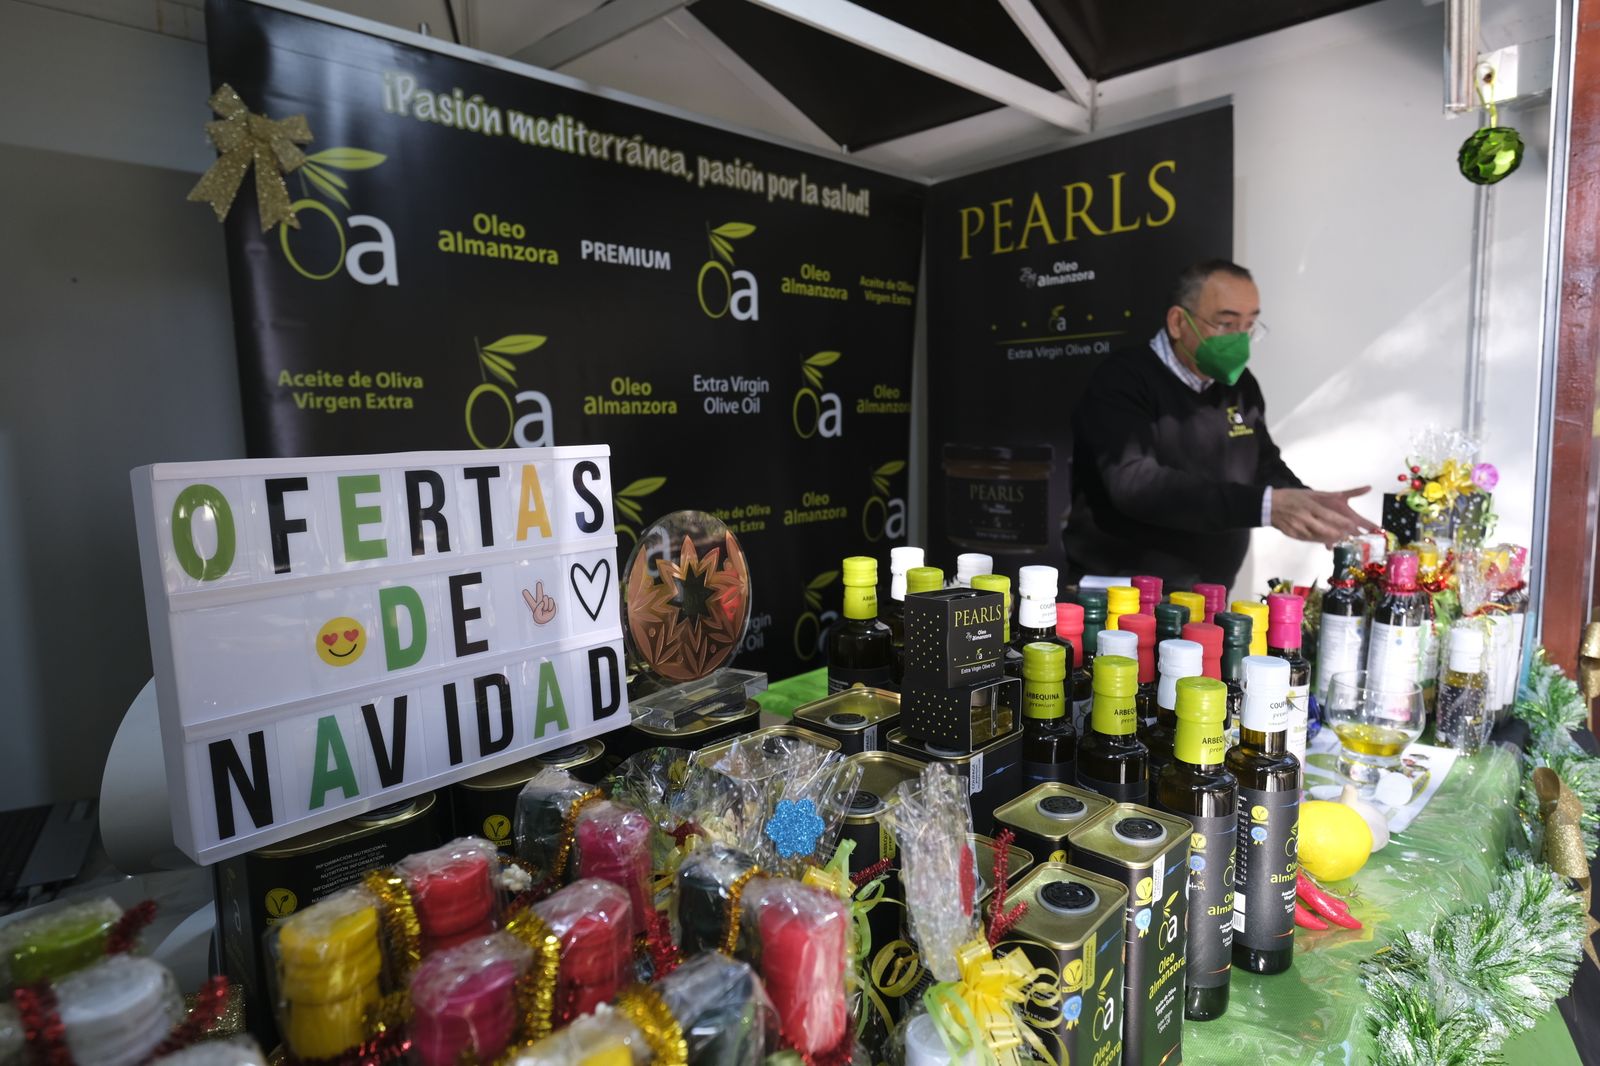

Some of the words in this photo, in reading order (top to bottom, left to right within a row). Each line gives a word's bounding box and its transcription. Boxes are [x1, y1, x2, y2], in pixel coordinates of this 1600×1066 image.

[508, 110, 694, 182] mediterránea,
[698, 156, 765, 193] pasión
[767, 174, 798, 201] por
[801, 173, 819, 205] la
[822, 184, 870, 217] salud!
[958, 160, 1177, 260] PEARLS
[473, 213, 526, 241] Oleo
[437, 230, 559, 265] almanzora
[580, 240, 671, 270] PREMIUM
[800, 263, 831, 282] Oleo
[1053, 261, 1078, 274] Oleo
[781, 277, 848, 300] almanzora
[1037, 269, 1095, 288] almanzora
[1007, 348, 1033, 361] Extra
[1035, 346, 1063, 361] Virgin
[1065, 343, 1091, 356] Olive
[1093, 341, 1110, 354] Oil
[277, 370, 344, 387] Aceite
[348, 371, 371, 388] de
[376, 371, 423, 389] Oliva
[611, 377, 652, 396] Oleo
[693, 374, 728, 392] Extra
[731, 376, 769, 397] Virgin
[873, 384, 900, 399] Oleo
[293, 392, 362, 413] Virgen
[366, 393, 414, 409] Extra
[584, 395, 677, 416] almanzora
[704, 396, 739, 414] Olive
[742, 397, 760, 414] Oil
[802, 492, 829, 508] Oleo
[969, 484, 1025, 502] PEARLS
[171, 460, 604, 581] OFERTAS
[746, 504, 771, 517] Oliva
[783, 504, 847, 526] almanzora
[740, 521, 765, 533] Extra
[378, 572, 489, 672] DE
[954, 604, 1002, 628] PEARLS
[208, 646, 622, 840] NAVIDAD
[1159, 952, 1174, 974] Oleo
[1149, 956, 1186, 999] almanzora
